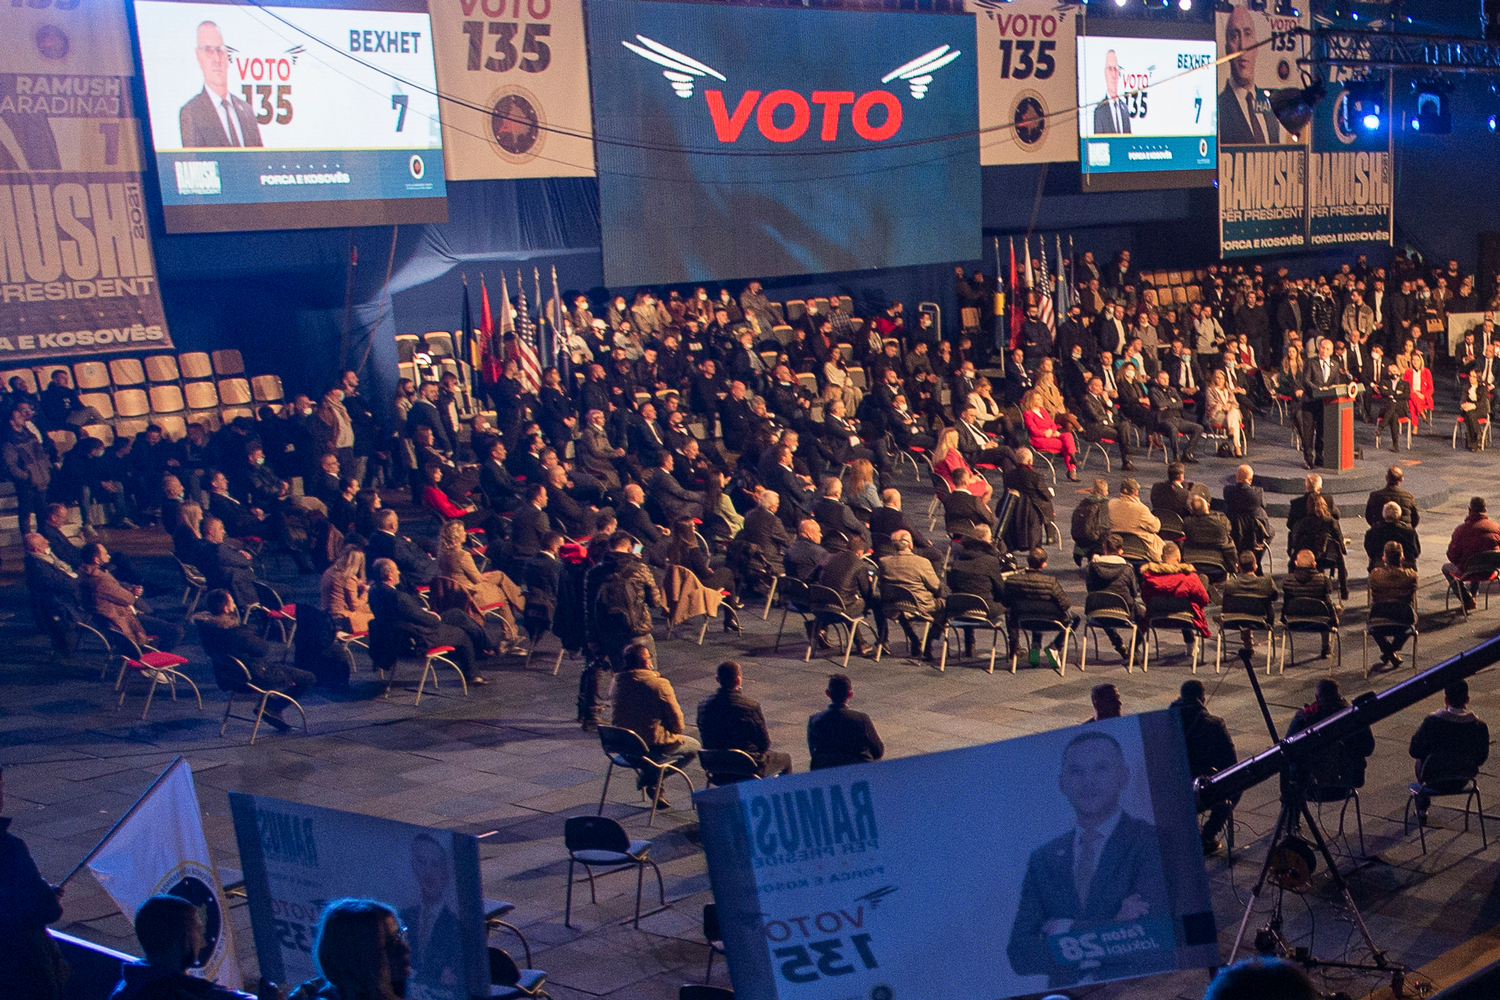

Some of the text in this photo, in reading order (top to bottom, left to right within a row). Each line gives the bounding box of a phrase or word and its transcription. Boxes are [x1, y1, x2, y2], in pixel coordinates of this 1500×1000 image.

[997, 13, 1057, 37] VOTO
[350, 29, 421, 53] BEXHET
[462, 21, 552, 73] 135
[236, 58, 290, 81] VOTO
[999, 40, 1056, 79] 135
[1177, 53, 1211, 69] BEXHET
[16, 76, 120, 97] RAMUSH
[1123, 74, 1149, 90] VOTO
[391, 94, 409, 132] 7
[704, 89, 903, 143] VOTO
[1194, 98, 1202, 124] 7
[99, 123, 119, 165] 1
[1244, 207, 1303, 221] PRESIDENT
[1330, 205, 1389, 217] PRESIDENT
[1253, 239, 1260, 248] E
[1261, 233, 1304, 248] KOSOVËS
[1344, 229, 1389, 242] KOSOVËS
[1, 277, 153, 303] RESIDENT
[18, 335, 36, 349] E
[39, 324, 163, 349] KOSOVËS
